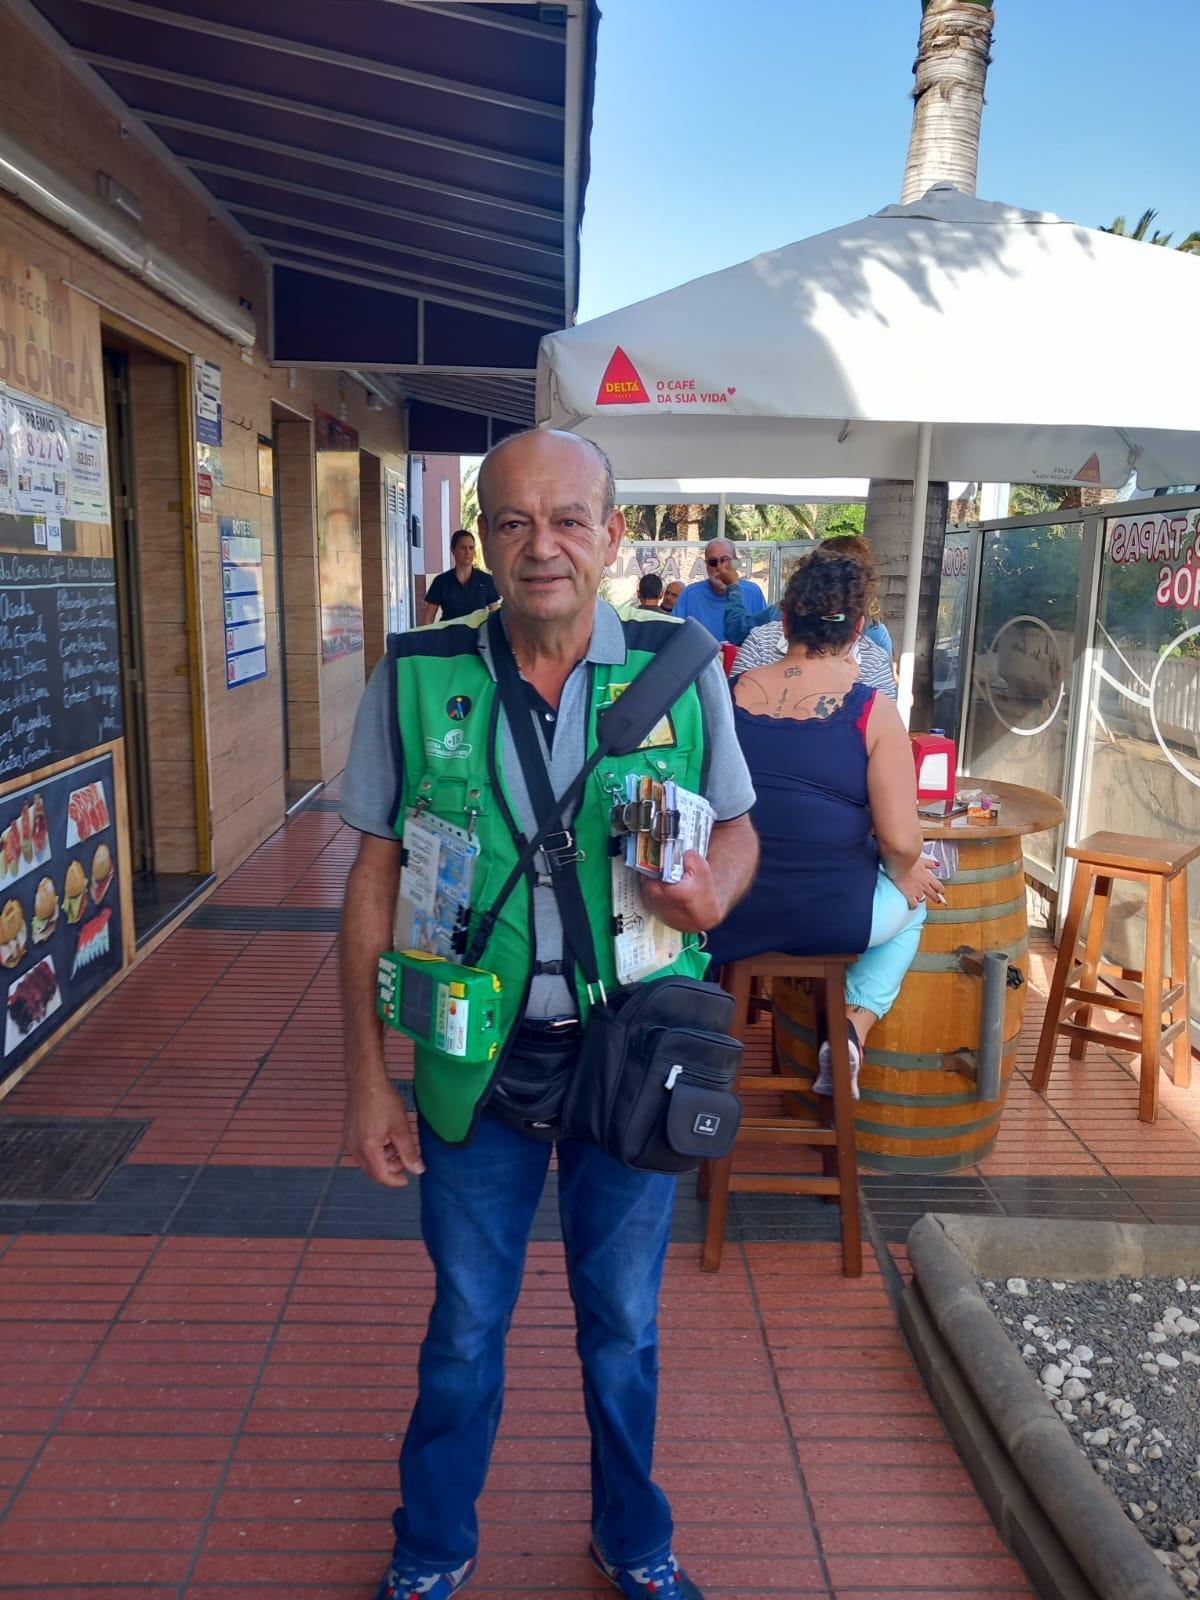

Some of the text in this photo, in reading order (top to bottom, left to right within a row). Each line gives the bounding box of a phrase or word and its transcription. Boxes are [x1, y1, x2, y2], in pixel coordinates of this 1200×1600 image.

[656, 381, 665, 391] O
[657, 393, 728, 404] DA SUA VIDA
[26, 411, 55, 434] PREMIO
